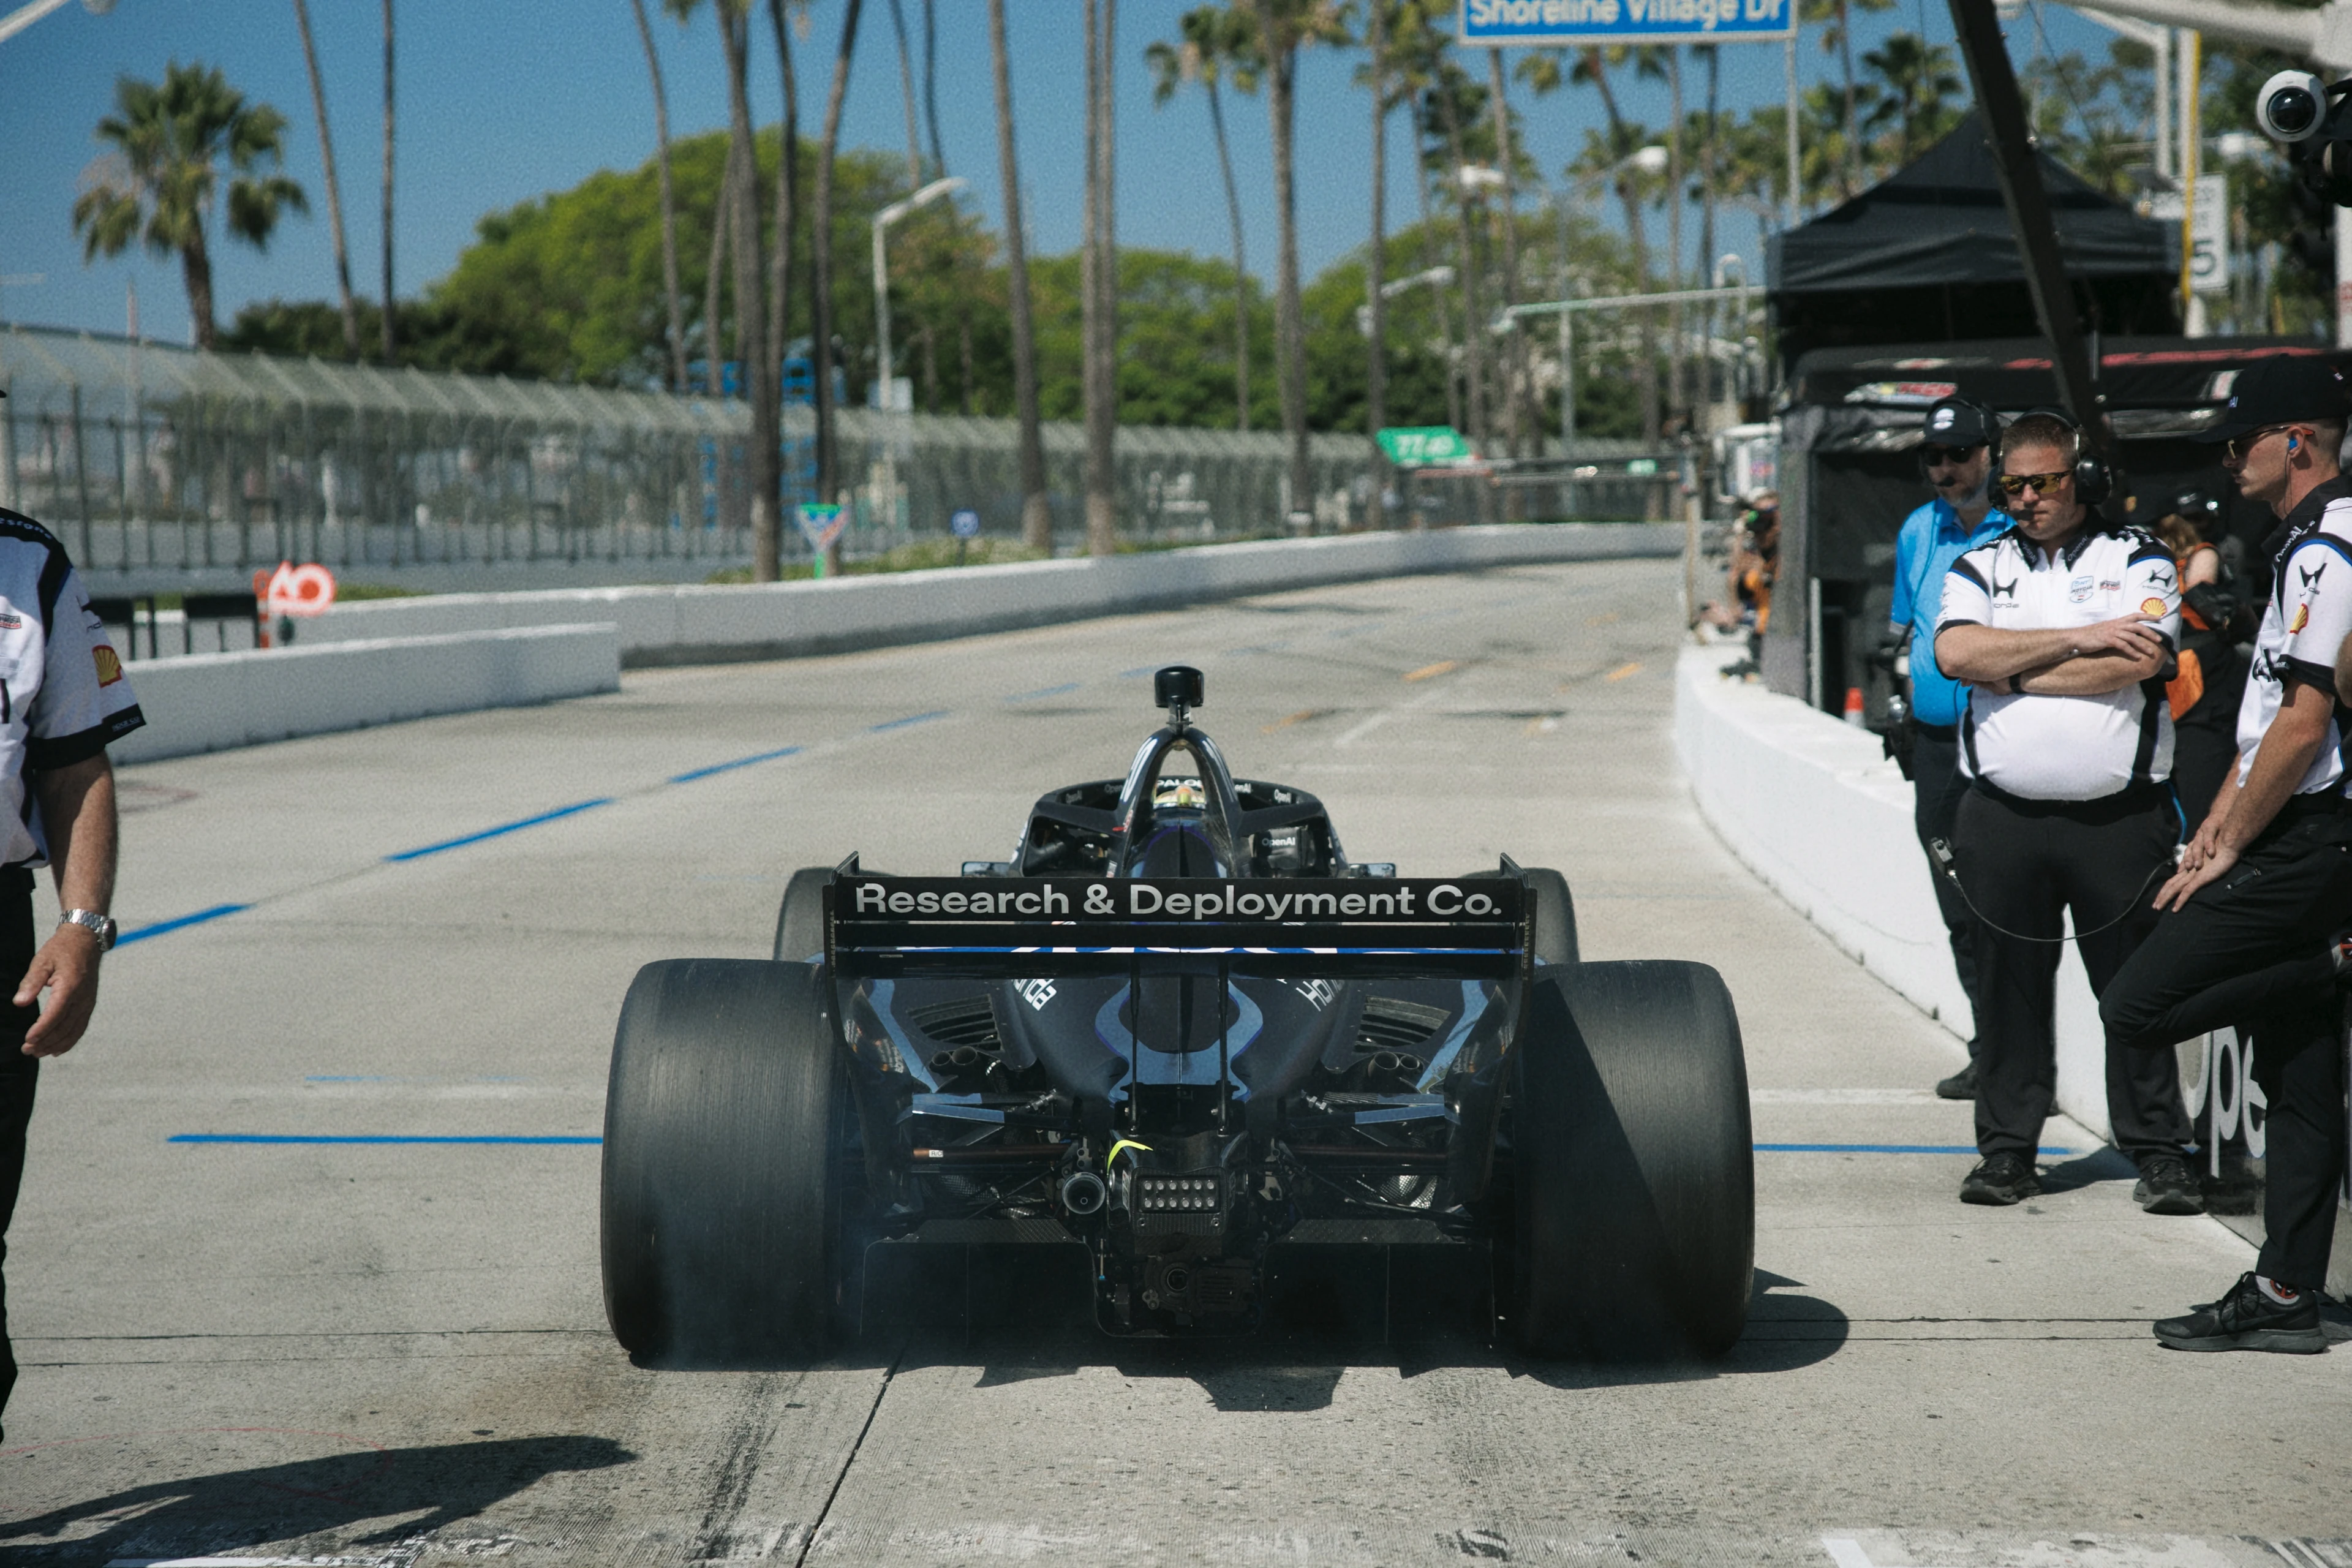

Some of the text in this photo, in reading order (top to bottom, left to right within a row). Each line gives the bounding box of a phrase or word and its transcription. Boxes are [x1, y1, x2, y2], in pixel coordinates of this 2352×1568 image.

[1469, 0, 1780, 30] Shoreline Village Dr
[1262, 837, 1296, 848] OpenAI
[856, 883, 1502, 921] Research & Deployment Co.
